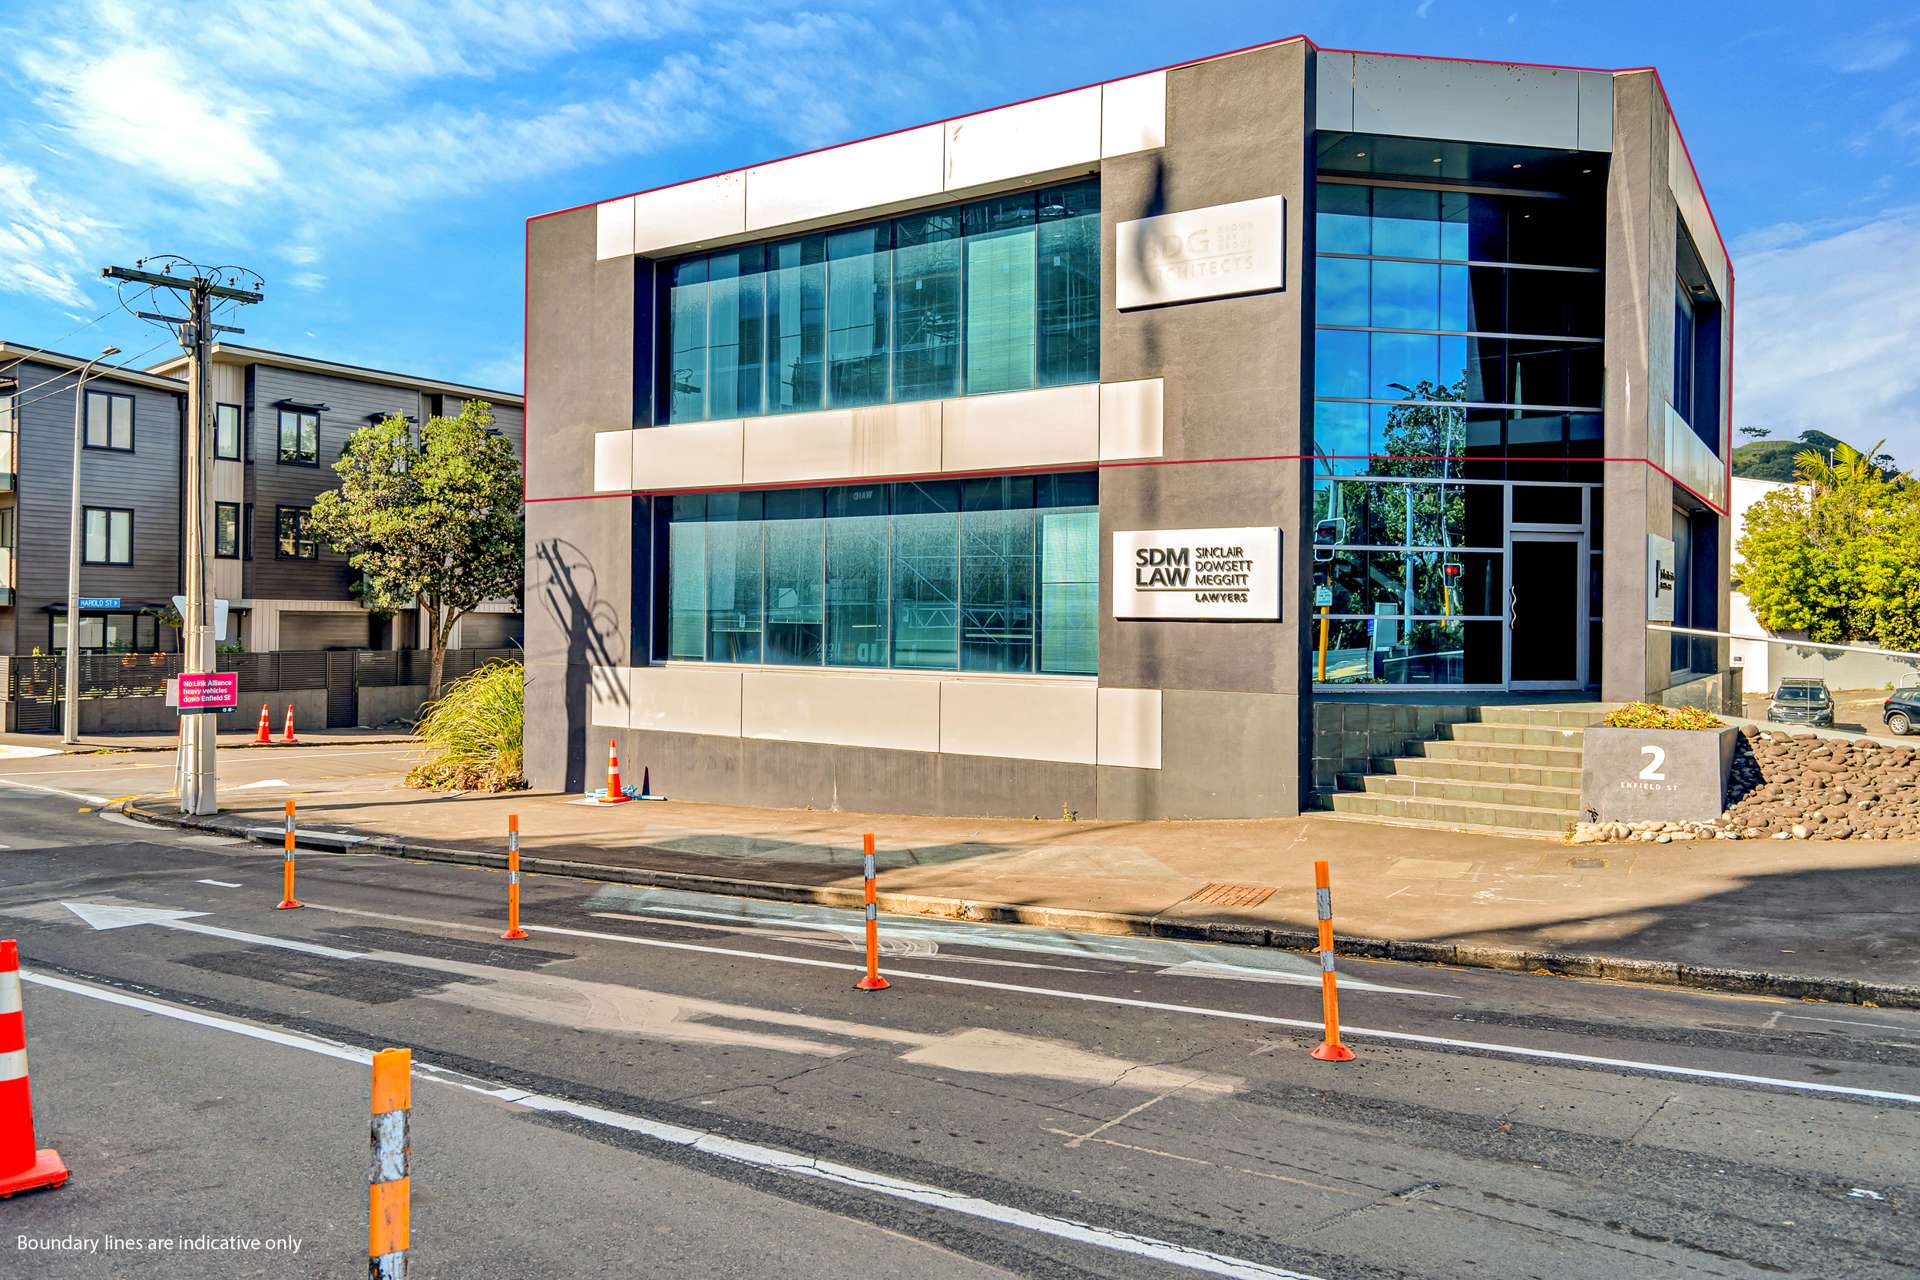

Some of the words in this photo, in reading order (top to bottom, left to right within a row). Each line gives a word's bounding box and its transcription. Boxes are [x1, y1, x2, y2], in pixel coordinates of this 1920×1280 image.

[1135, 547, 1190, 567] SDM
[1195, 546, 1244, 559] SINCLAIR
[1195, 560, 1253, 572] DOWSETT
[1135, 567, 1191, 587] LAW
[1195, 573, 1249, 586] MEGGITT
[80, 599, 104, 607] HAROLD
[1195, 592, 1248, 603] LAWYERS
[183, 688, 202, 696] heavy
[183, 695, 201, 703] down
[1639, 745, 1666, 781] 2
[1620, 781, 1661, 791] ENFIELD
[1666, 784, 1678, 792] ST
